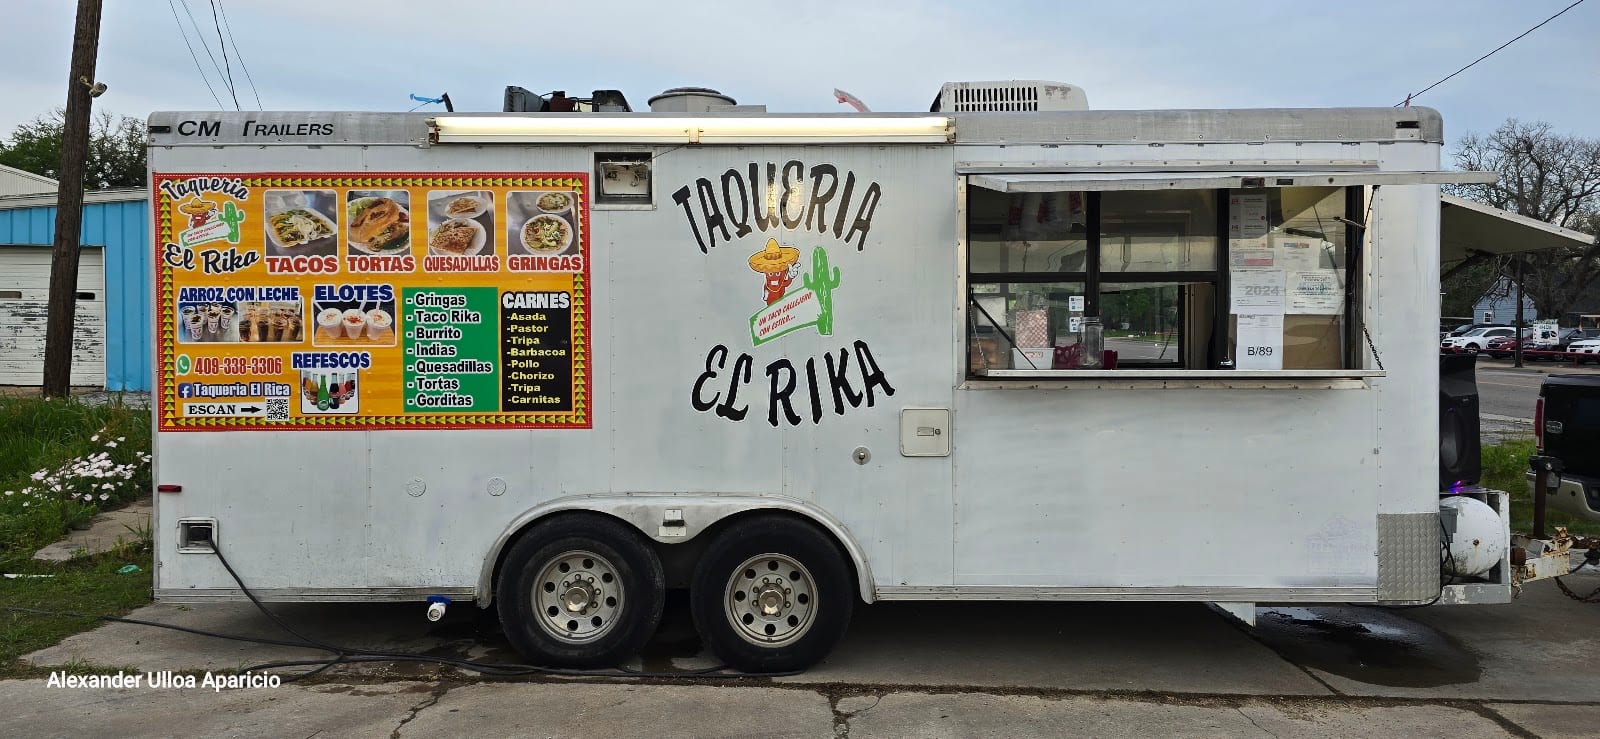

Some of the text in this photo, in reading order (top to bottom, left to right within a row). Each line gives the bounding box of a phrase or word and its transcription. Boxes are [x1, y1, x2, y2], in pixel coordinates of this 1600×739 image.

[178, 120, 222, 137] CM
[161, 177, 249, 201] Taqueria
[672, 159, 882, 254] TAQUERIA
[165, 244, 259, 274] El Rika
[266, 257, 338, 273] TACOS
[347, 256, 415, 272] TORTAS
[424, 256, 499, 271] QUESADILLAS
[508, 256, 582, 271] GRINGAS
[179, 287, 299, 302] ARROZ CON LECHE
[314, 285, 393, 301] ELOTES
[1245, 285, 1280, 296] 2024
[415, 294, 466, 308] Gringas
[502, 292, 570, 309] CARNES
[416, 310, 480, 323] Taco Rika
[416, 327, 461, 339] Burrito
[416, 344, 456, 356] Indias
[1247, 346, 1273, 356] B/89
[194, 357, 282, 375] 409-338-3306
[293, 353, 370, 368] REFESCOS
[416, 360, 492, 374] Quesadillas
[194, 383, 291, 398] Taqueria El Rica
[416, 378, 459, 390] Tortas
[691, 339, 896, 427] EL RIKA
[416, 394, 473, 407] Gorditas
[188, 405, 236, 415] ESCAN
